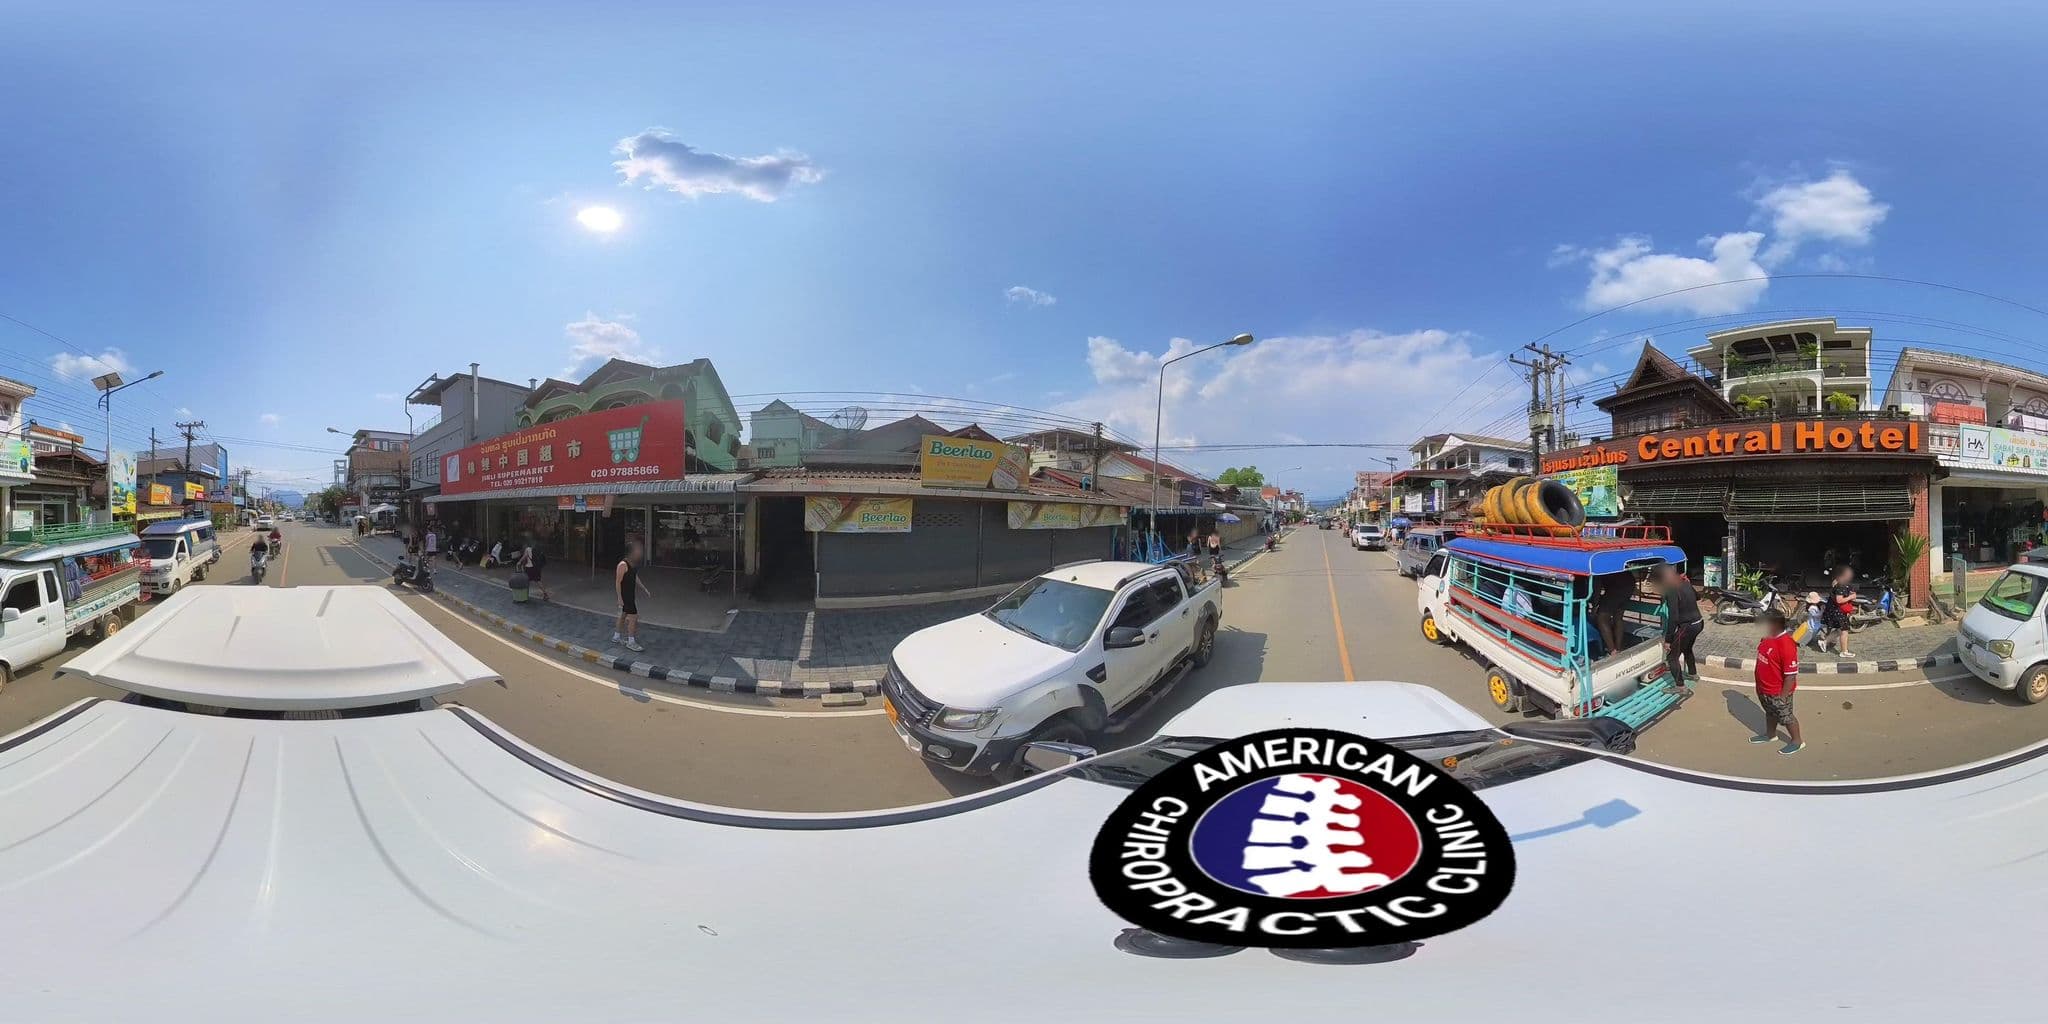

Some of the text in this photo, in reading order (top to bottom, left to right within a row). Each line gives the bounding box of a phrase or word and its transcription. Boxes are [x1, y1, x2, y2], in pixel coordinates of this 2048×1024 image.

[1637, 421, 1919, 461] Central Hotel
[930, 440, 994, 460] Beerlao
[497, 465, 554, 479] SUPERMARKET
[591, 465, 660, 478] 020 97885866
[862, 512, 907, 523] Beerlao
